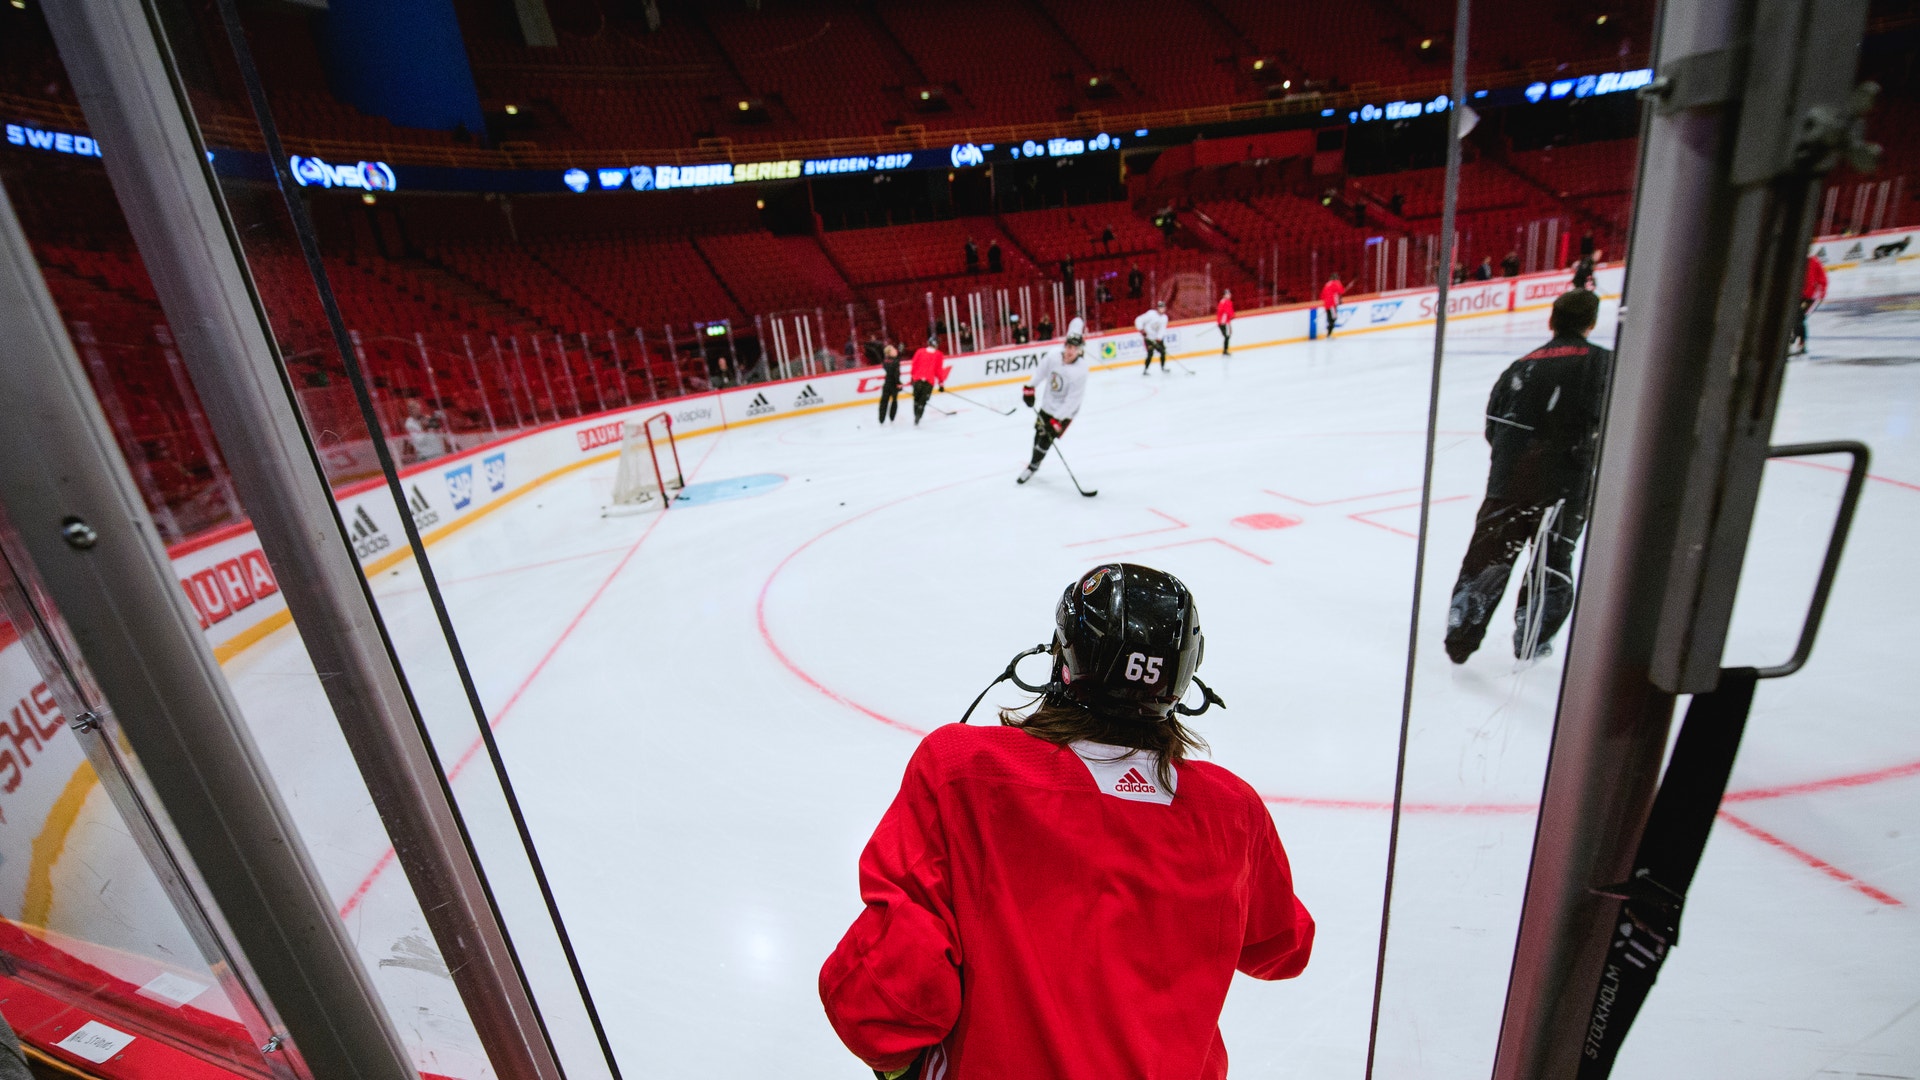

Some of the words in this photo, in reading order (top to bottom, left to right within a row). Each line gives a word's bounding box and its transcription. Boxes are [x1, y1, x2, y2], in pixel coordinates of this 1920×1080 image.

[1124, 651, 1164, 686] 65
[1115, 782, 1156, 795] adidas
[1584, 963, 1621, 1060] STOCKHOLM
